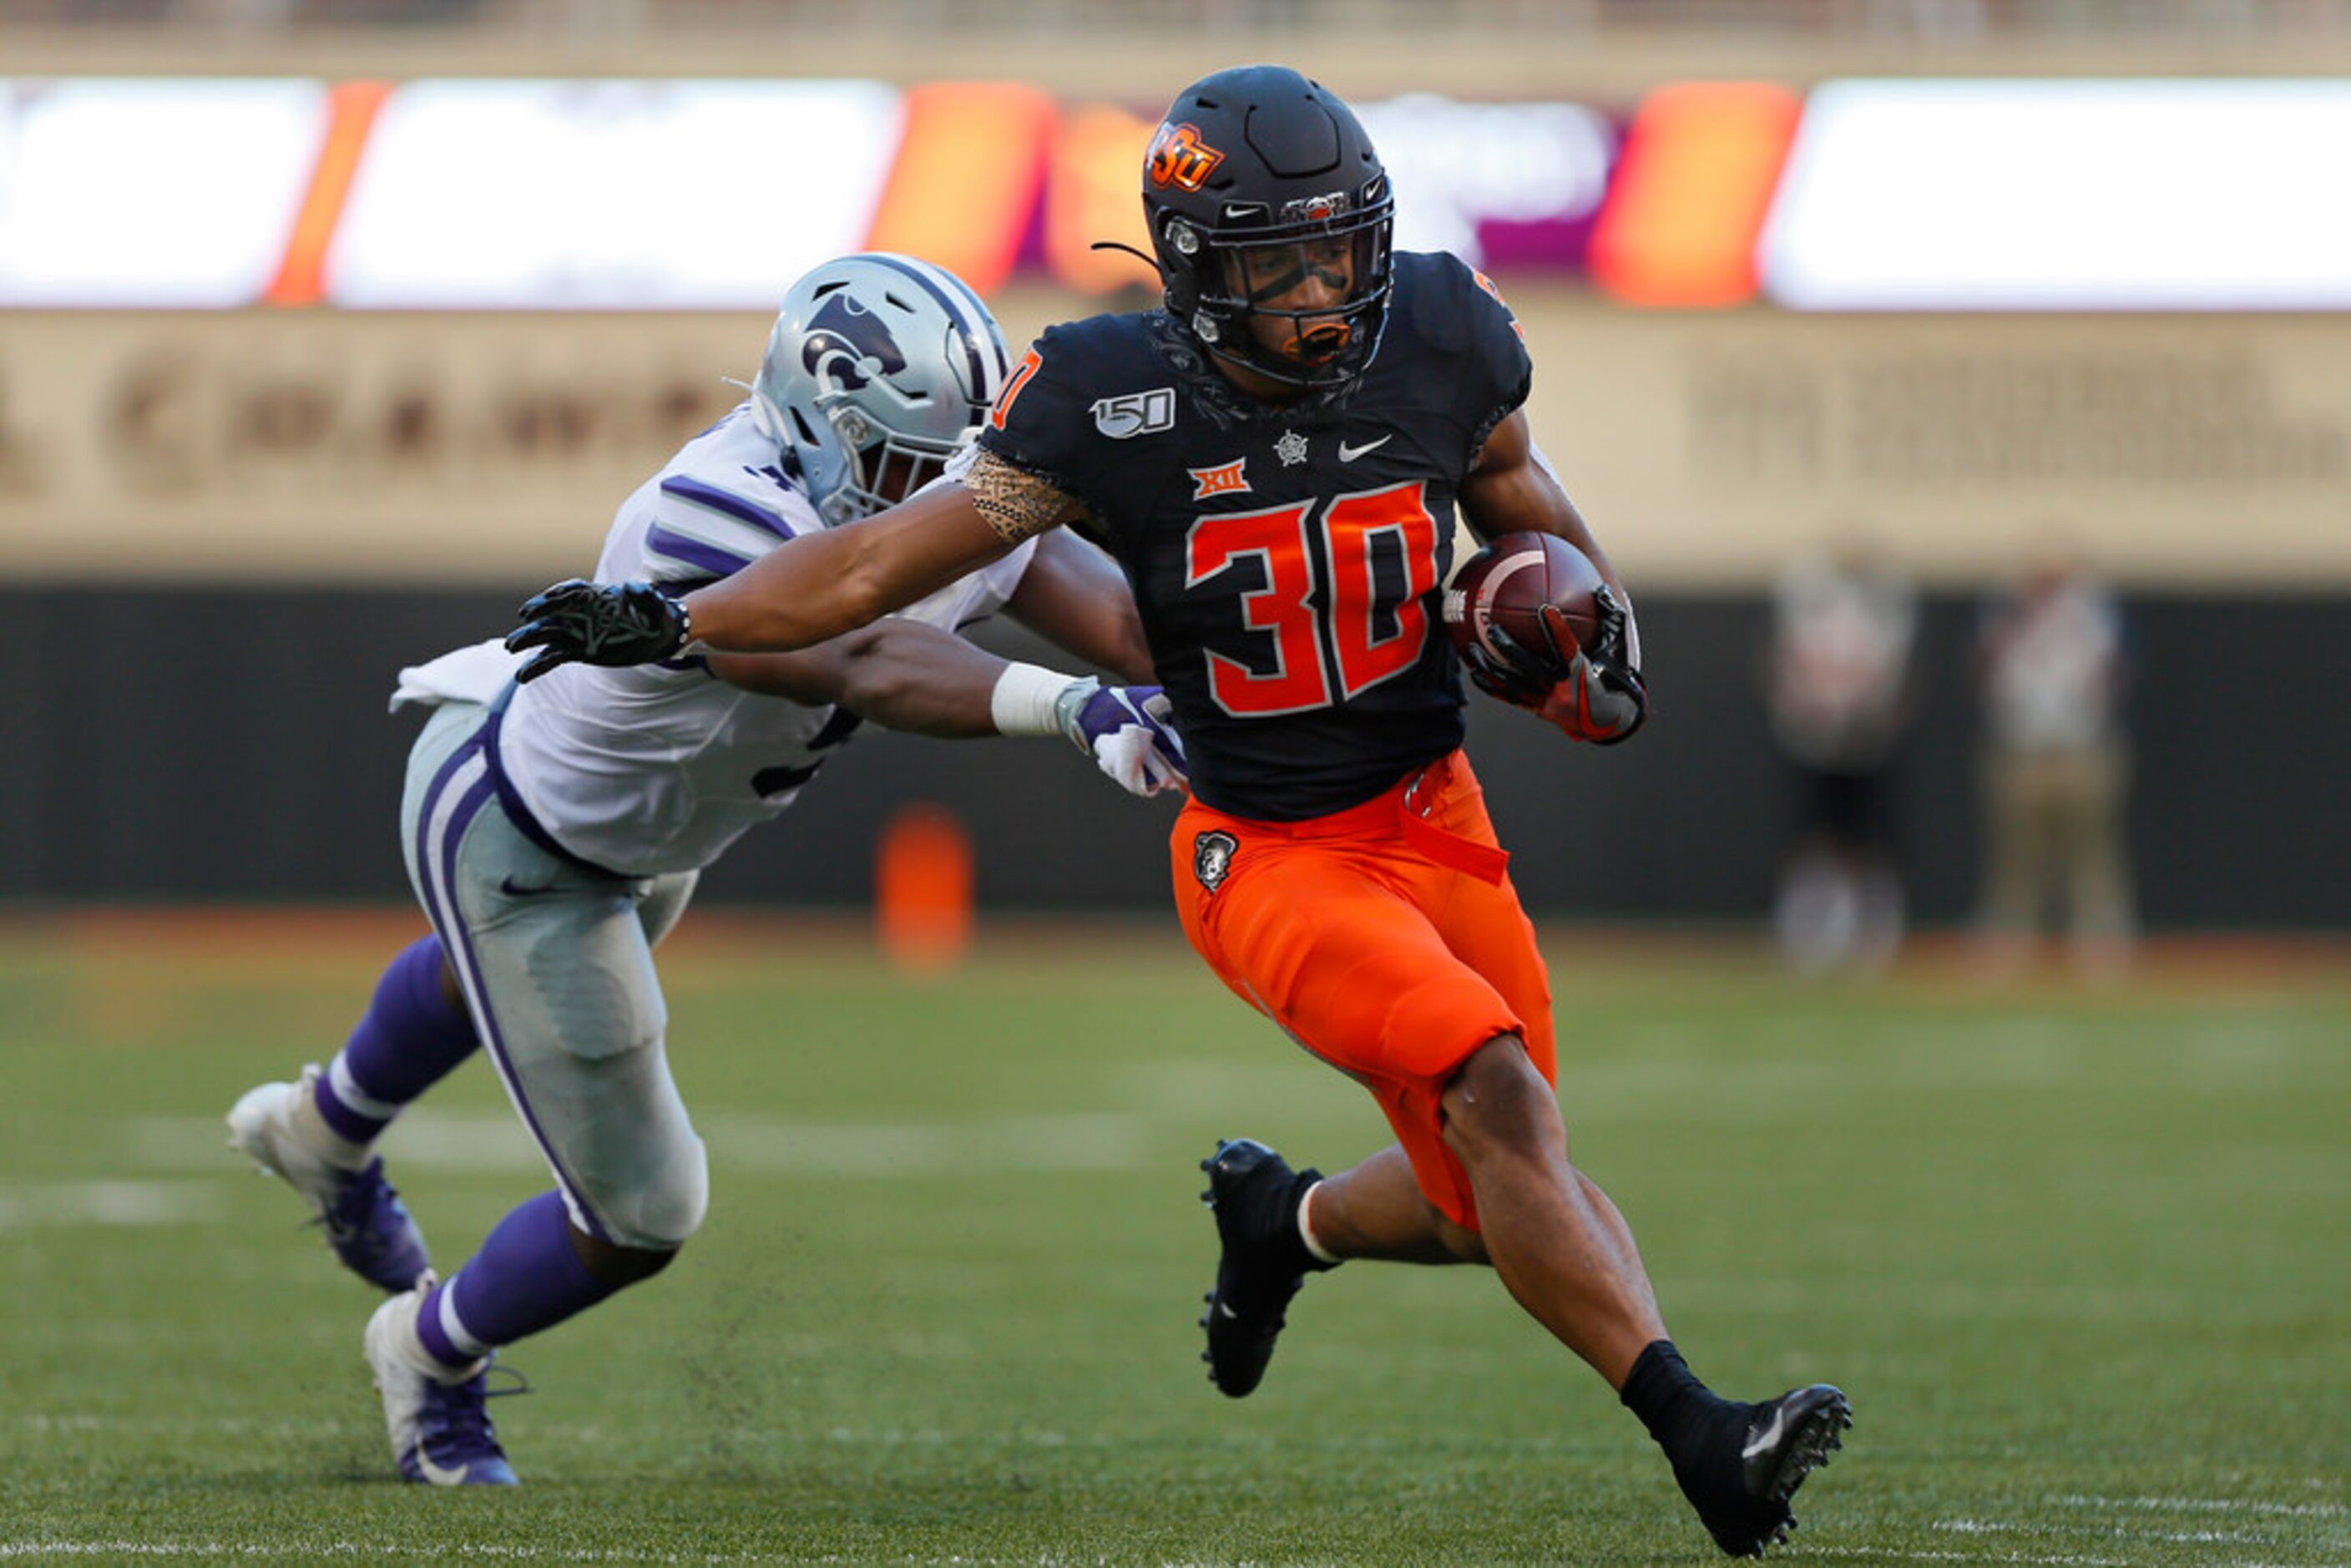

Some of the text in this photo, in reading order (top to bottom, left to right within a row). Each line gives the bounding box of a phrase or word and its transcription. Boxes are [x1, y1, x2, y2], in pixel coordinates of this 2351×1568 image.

[1092, 387, 1175, 438] 150
[1191, 461, 1250, 499] XII
[1185, 480, 1439, 718] 30
